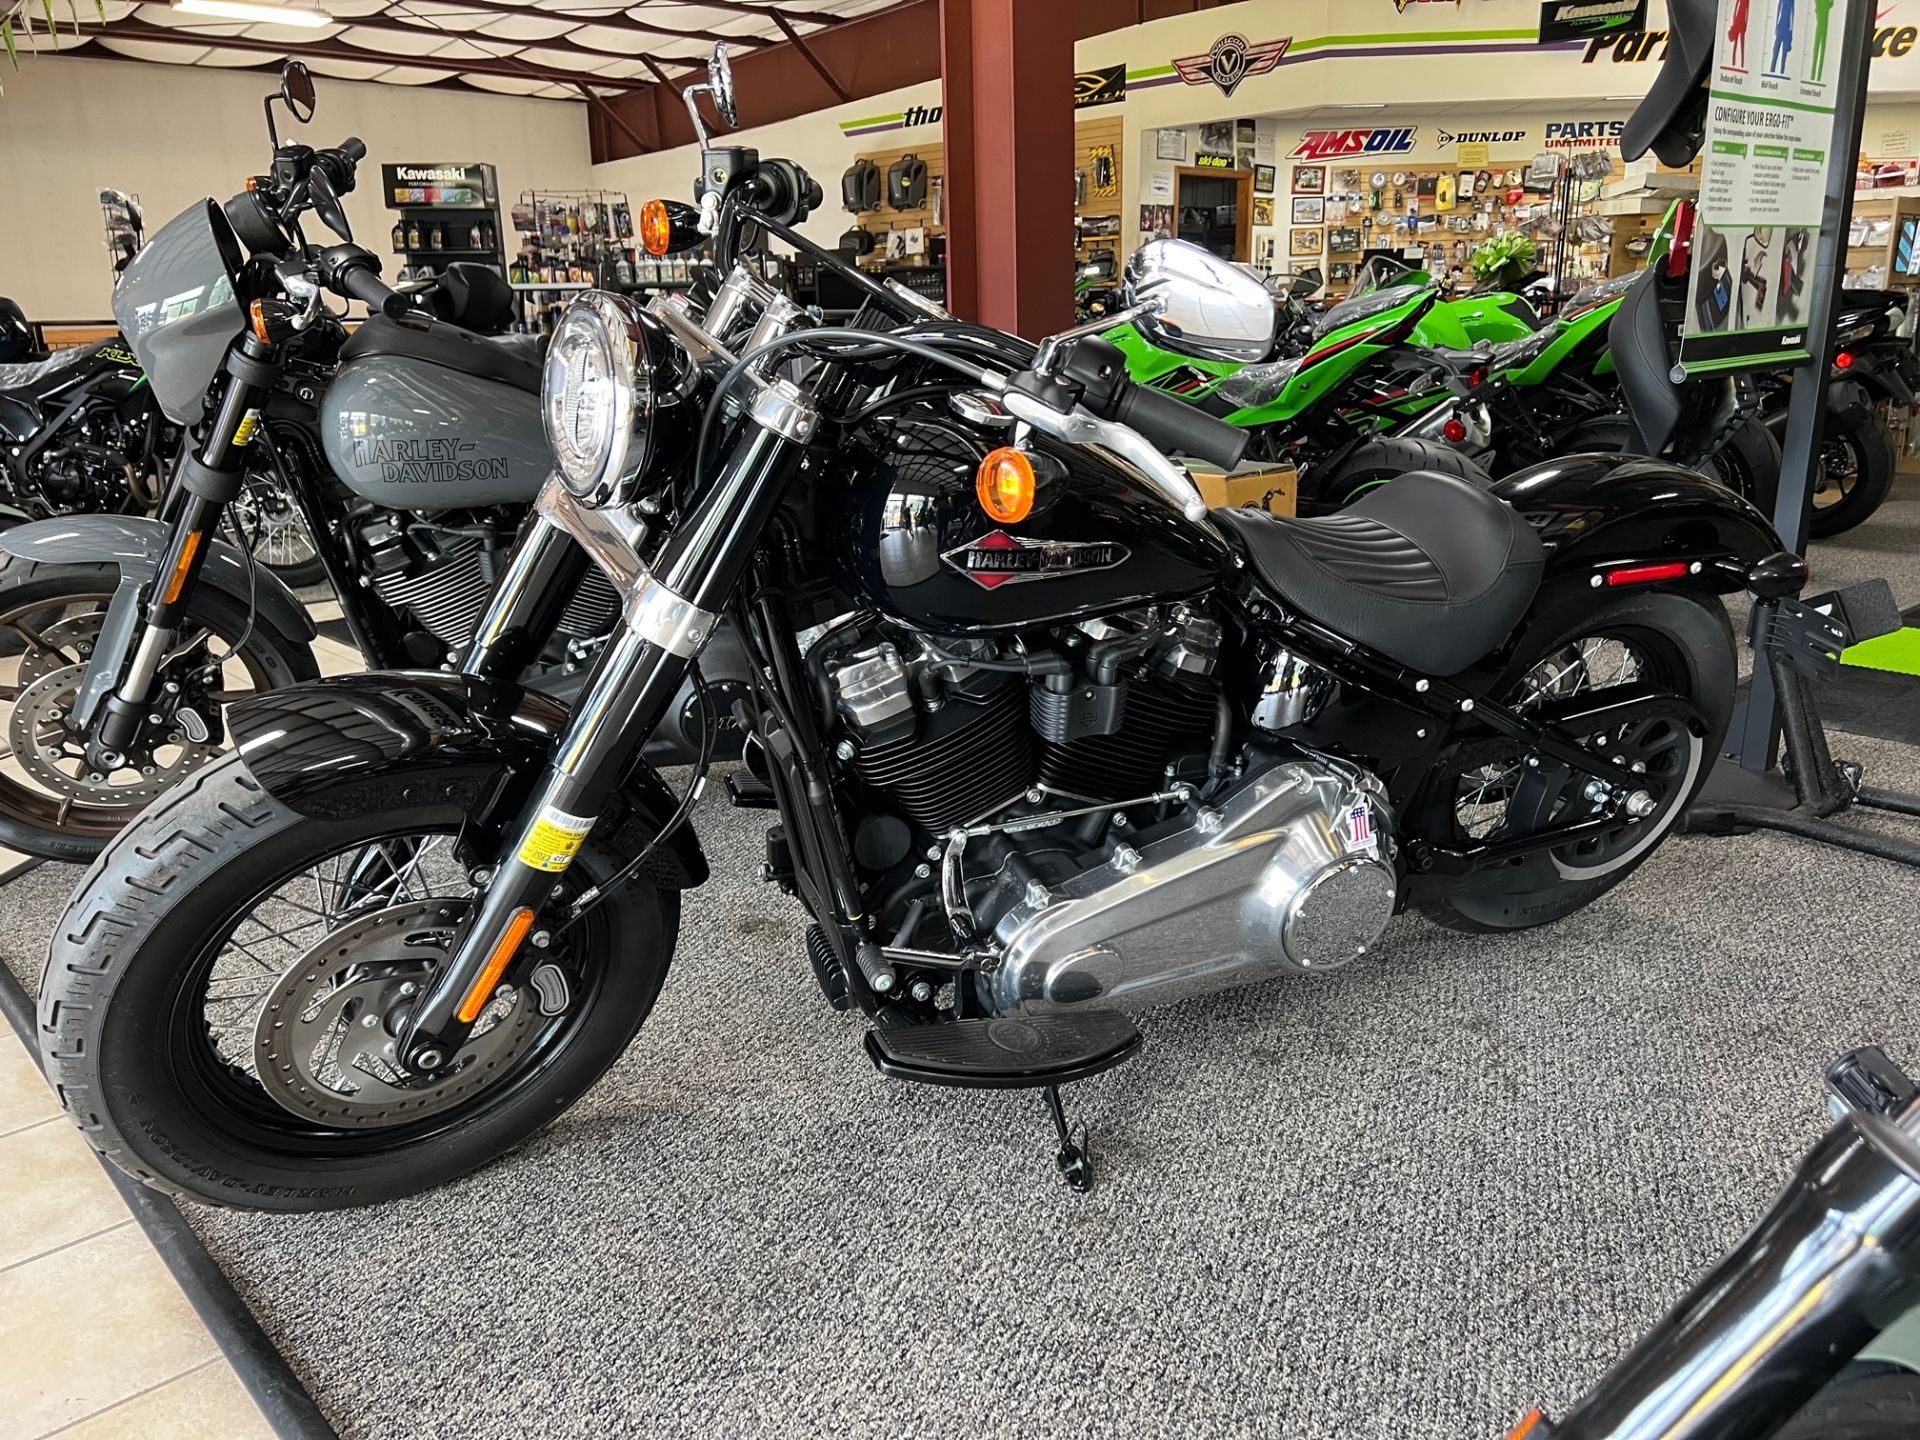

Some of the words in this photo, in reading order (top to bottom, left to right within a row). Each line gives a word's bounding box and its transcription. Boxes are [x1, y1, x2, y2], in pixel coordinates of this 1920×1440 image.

[1554, 0, 1639, 21] Kawasaki
[1210, 36, 1247, 57] Vulcan
[1582, 30, 1670, 64] Par
[1075, 89, 1126, 105] MITH
[1715, 106, 1746, 124] CONFIGURE
[1747, 110, 1764, 126] YOUR
[1455, 130, 1526, 143] DUNLOP
[1545, 120, 1625, 139] PARTS
[1294, 128, 1415, 160] AMSOIL
[1545, 138, 1621, 149] UNLIMITED
[396, 166, 466, 181] Kawasaki
[353, 438, 476, 468] HARLEY-
[381, 457, 510, 483] DAVIDSON
[966, 547, 1114, 569] HARLEY-DAVIDSON
